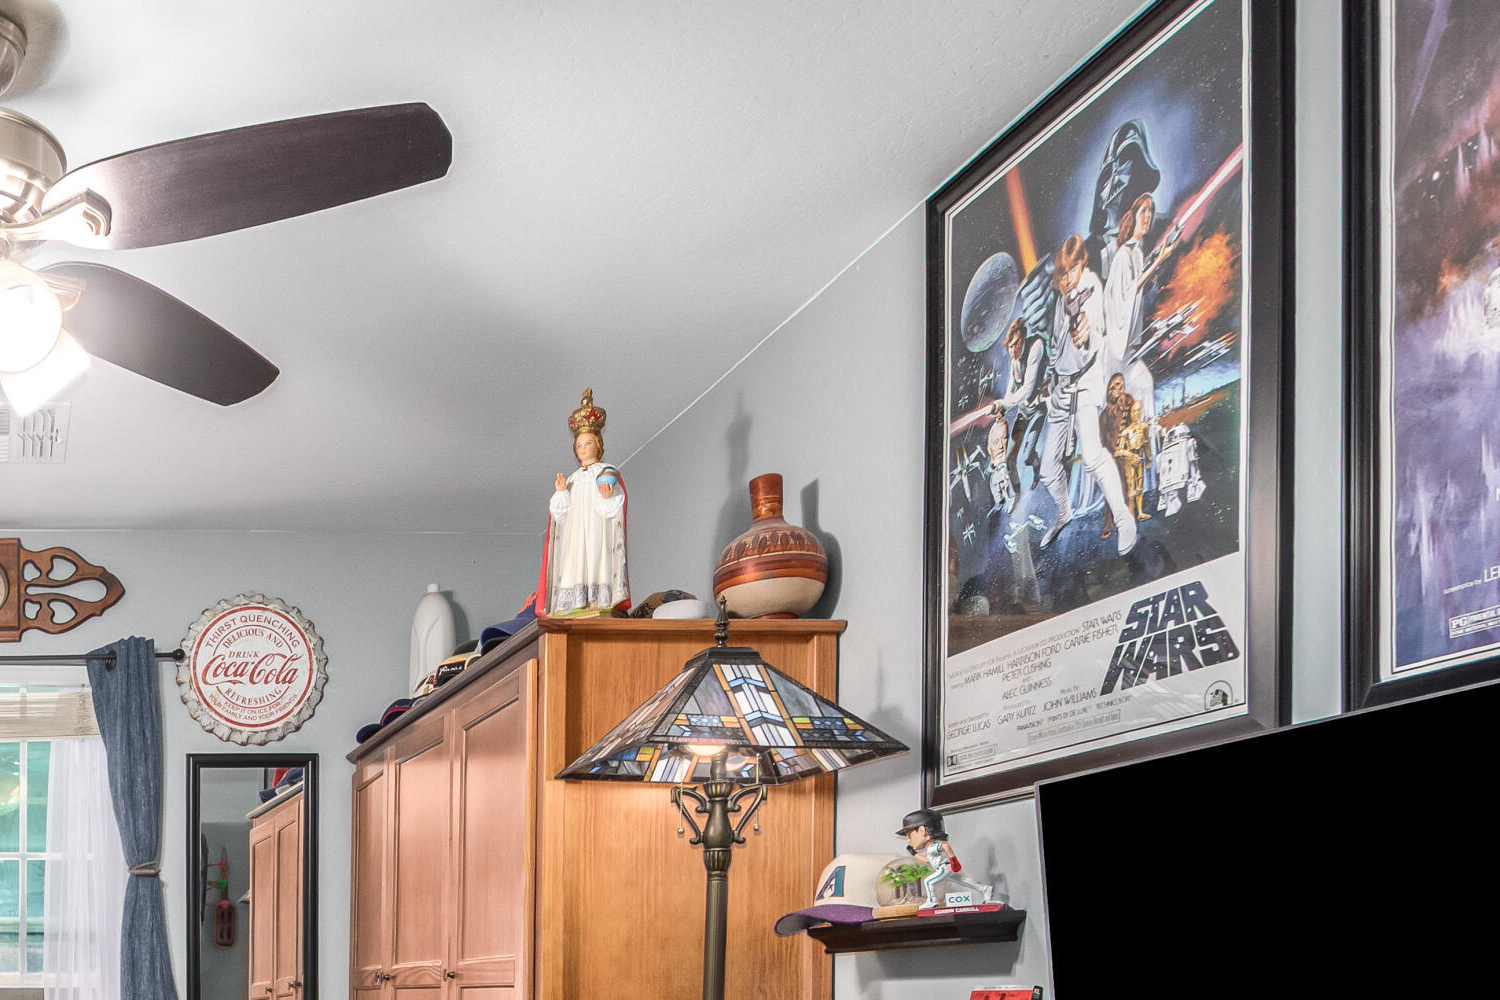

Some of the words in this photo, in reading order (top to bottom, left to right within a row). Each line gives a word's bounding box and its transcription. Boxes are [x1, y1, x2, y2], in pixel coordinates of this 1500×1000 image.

[1082, 617, 1099, 632] STAR
[1100, 610, 1123, 625] WARS
[1118, 580, 1218, 644] STAR
[205, 617, 238, 649] THIRST
[240, 614, 301, 649] QUENCHING
[1451, 617, 1468, 629] PG
[222, 628, 264, 649] DELICIOUS
[267, 633, 284, 648] AND
[228, 651, 260, 659] DRINK
[964, 672, 981, 685] MARK
[982, 663, 1005, 678] HAMILL
[1006, 650, 1040, 670] HARRISON
[1041, 643, 1061, 659] FORD
[1064, 631, 1091, 650] CARRIE
[1092, 624, 1119, 642] FISHER
[1100, 615, 1241, 696] WARS
[201, 653, 303, 686] Coca-Cola
[1002, 668, 1022, 683] PETER
[1022, 658, 1051, 676] CUSHING
[224, 688, 282, 706] REFRESHING
[1002, 686, 1018, 700] ALEC
[1019, 676, 1052, 696] GUINNESS
[224, 701, 239, 712] KEEP
[258, 706, 269, 714] ICE
[1042, 700, 1062, 712] JOHN
[1063, 688, 1097, 705] WILLIAMS
[221, 704, 242, 719] FAMILY
[258, 711, 275, 720] YOUR
[996, 711, 1015, 725] GARY
[1015, 705, 1037, 720] KURTZ
[947, 725, 972, 740] GEORGE
[972, 720, 991, 733] LUCAS
[948, 895, 970, 903] COX
